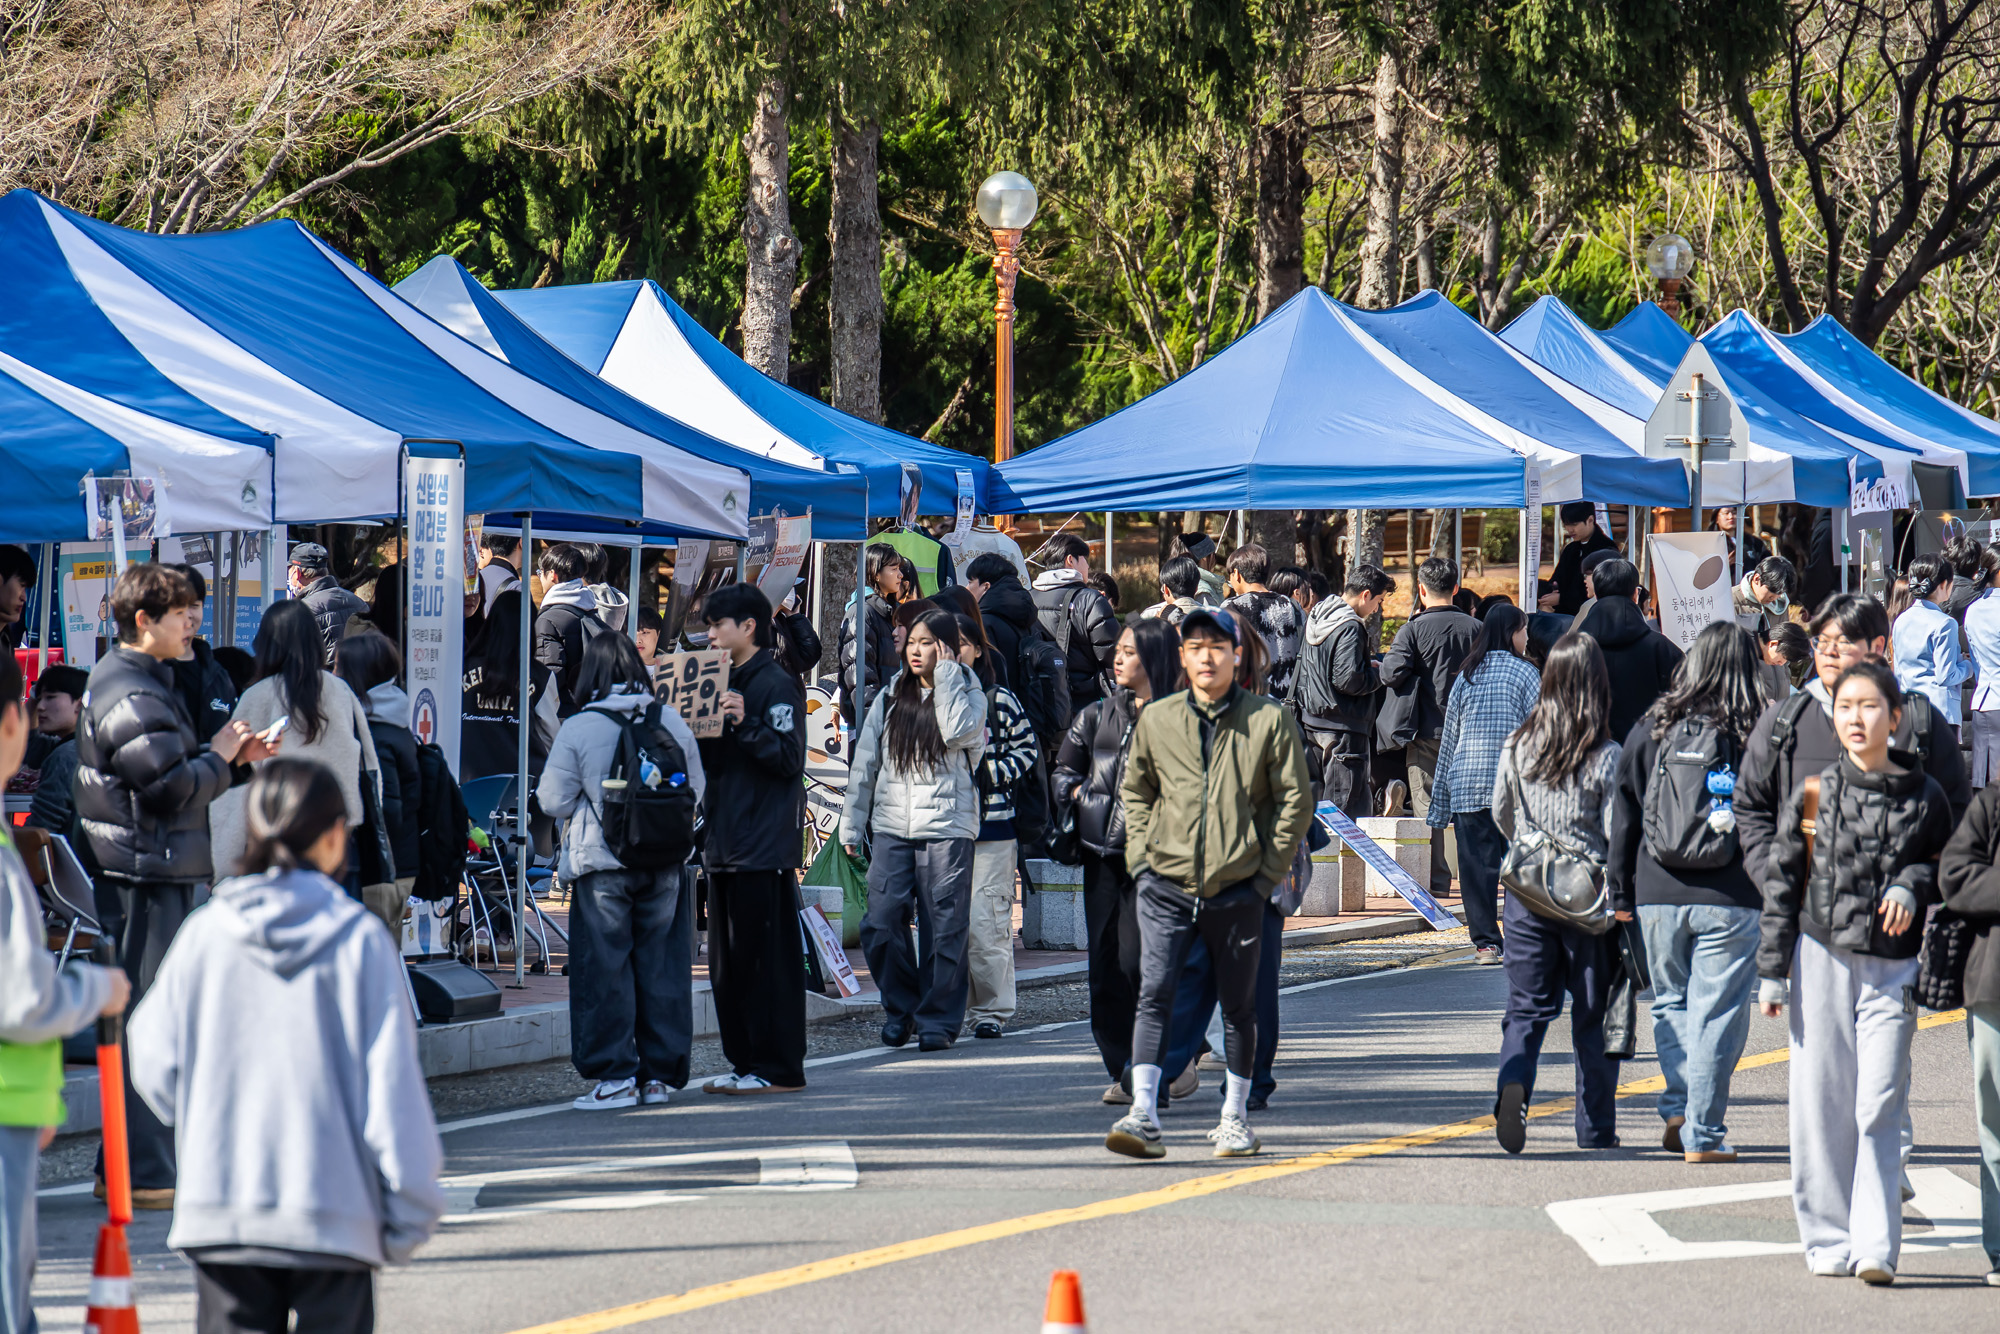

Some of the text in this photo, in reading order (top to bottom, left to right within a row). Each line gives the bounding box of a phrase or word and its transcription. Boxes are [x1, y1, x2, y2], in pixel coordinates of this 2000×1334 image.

[416, 473, 448, 505] 신입생
[415, 510, 447, 542] 여러분
[412, 583, 444, 616] 합니다
[1672, 596, 1714, 611] 동아리에서
[1677, 612, 1711, 628] 카페처럼
[461, 712, 504, 723] International
